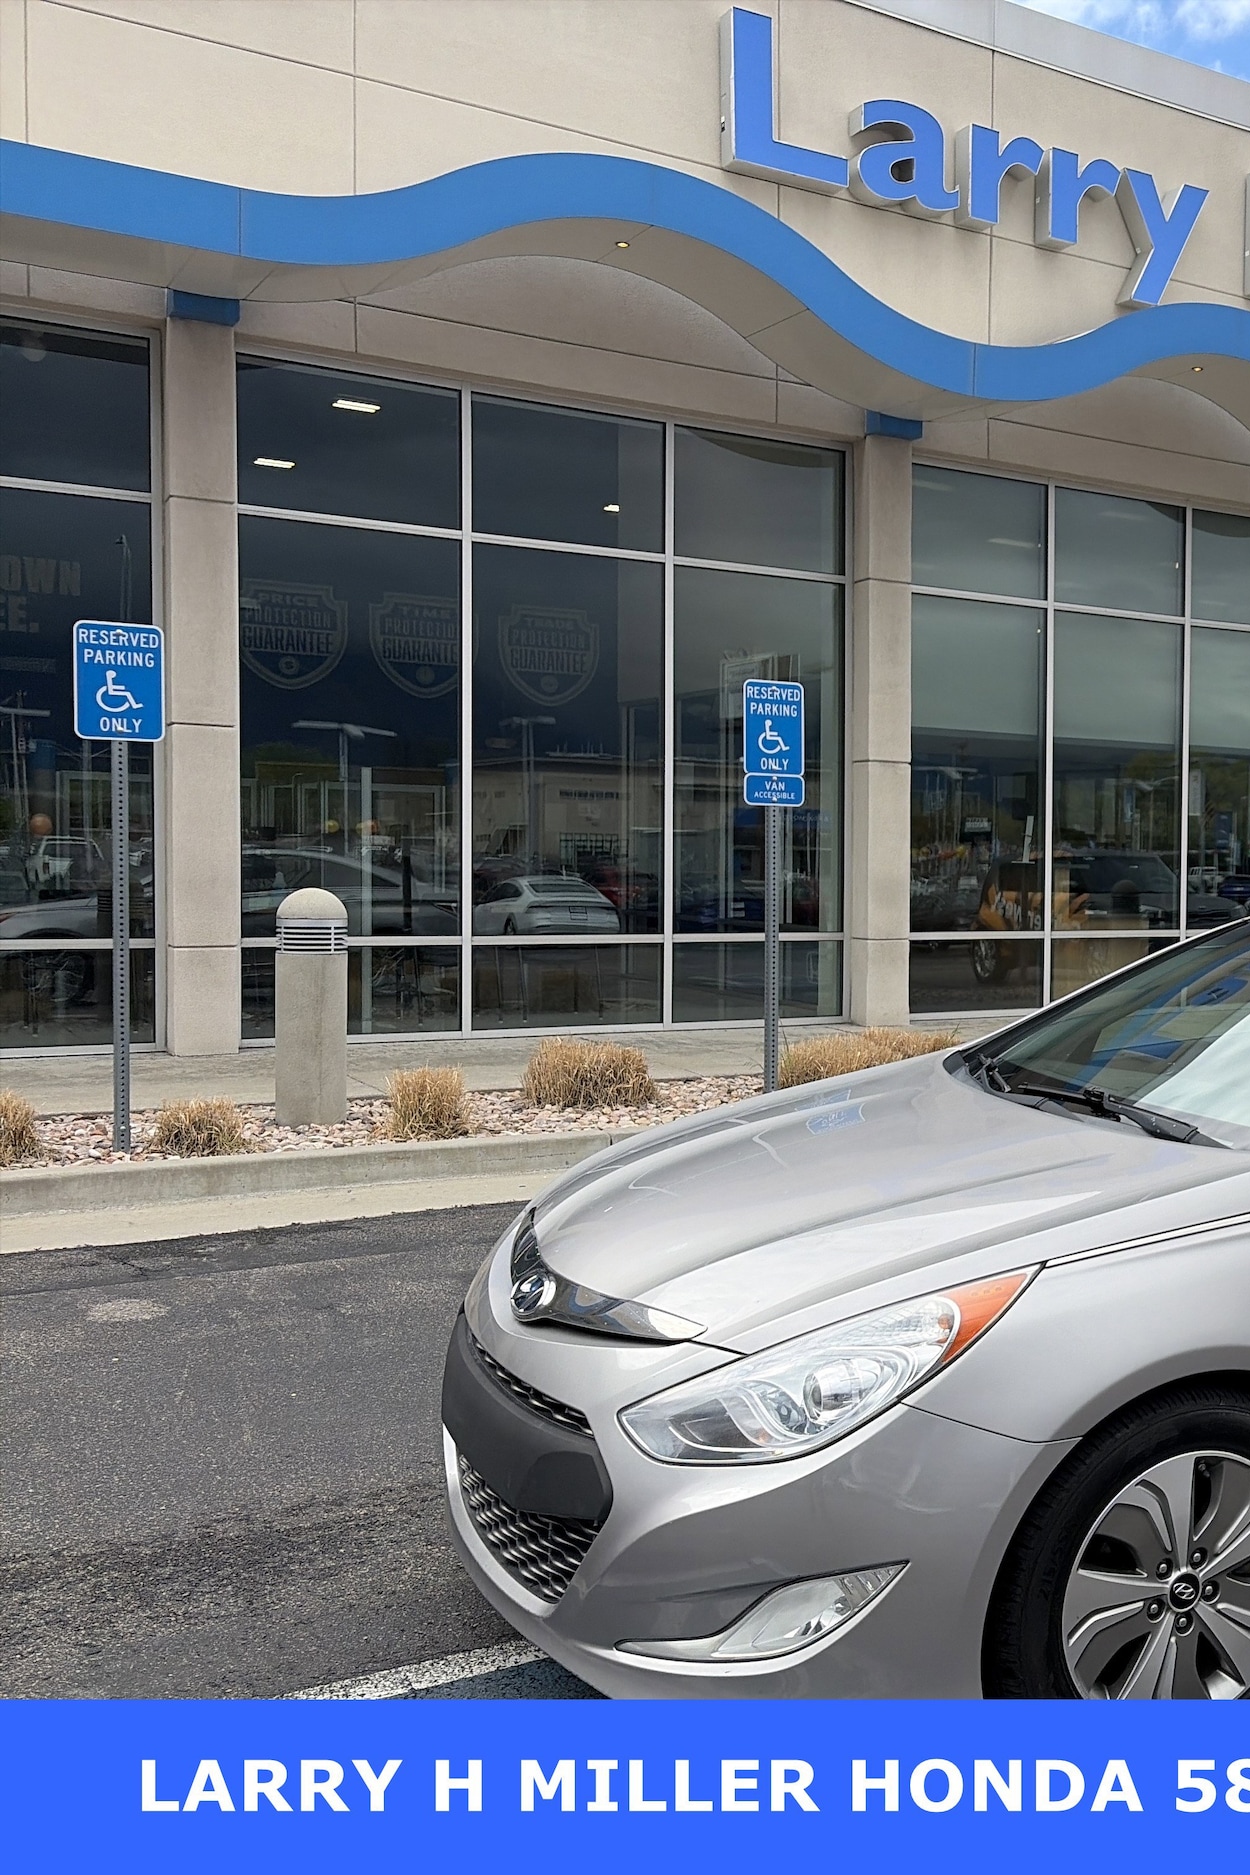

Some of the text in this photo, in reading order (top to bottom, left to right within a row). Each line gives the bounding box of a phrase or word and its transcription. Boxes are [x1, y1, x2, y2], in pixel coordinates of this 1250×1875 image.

[719, 6, 1210, 306] Larry
[245, 605, 332, 629] PROTECTION
[78, 628, 159, 649] RESERVED
[384, 616, 458, 640] PROTECTIO
[512, 627, 586, 650] PROTECTION
[242, 626, 334, 655] GUARANTEE
[83, 649, 155, 668] PARKING
[382, 637, 458, 666] GUARANTE
[510, 647, 588, 675] GUARANTEE
[747, 686, 800, 702] RESERVED
[750, 702, 798, 718] PARKING
[99, 716, 143, 734] ONLY
[760, 757, 789, 771] ONLY
[754, 791, 795, 800] ACCESSIBLE
[765, 781, 785, 791] VAN
